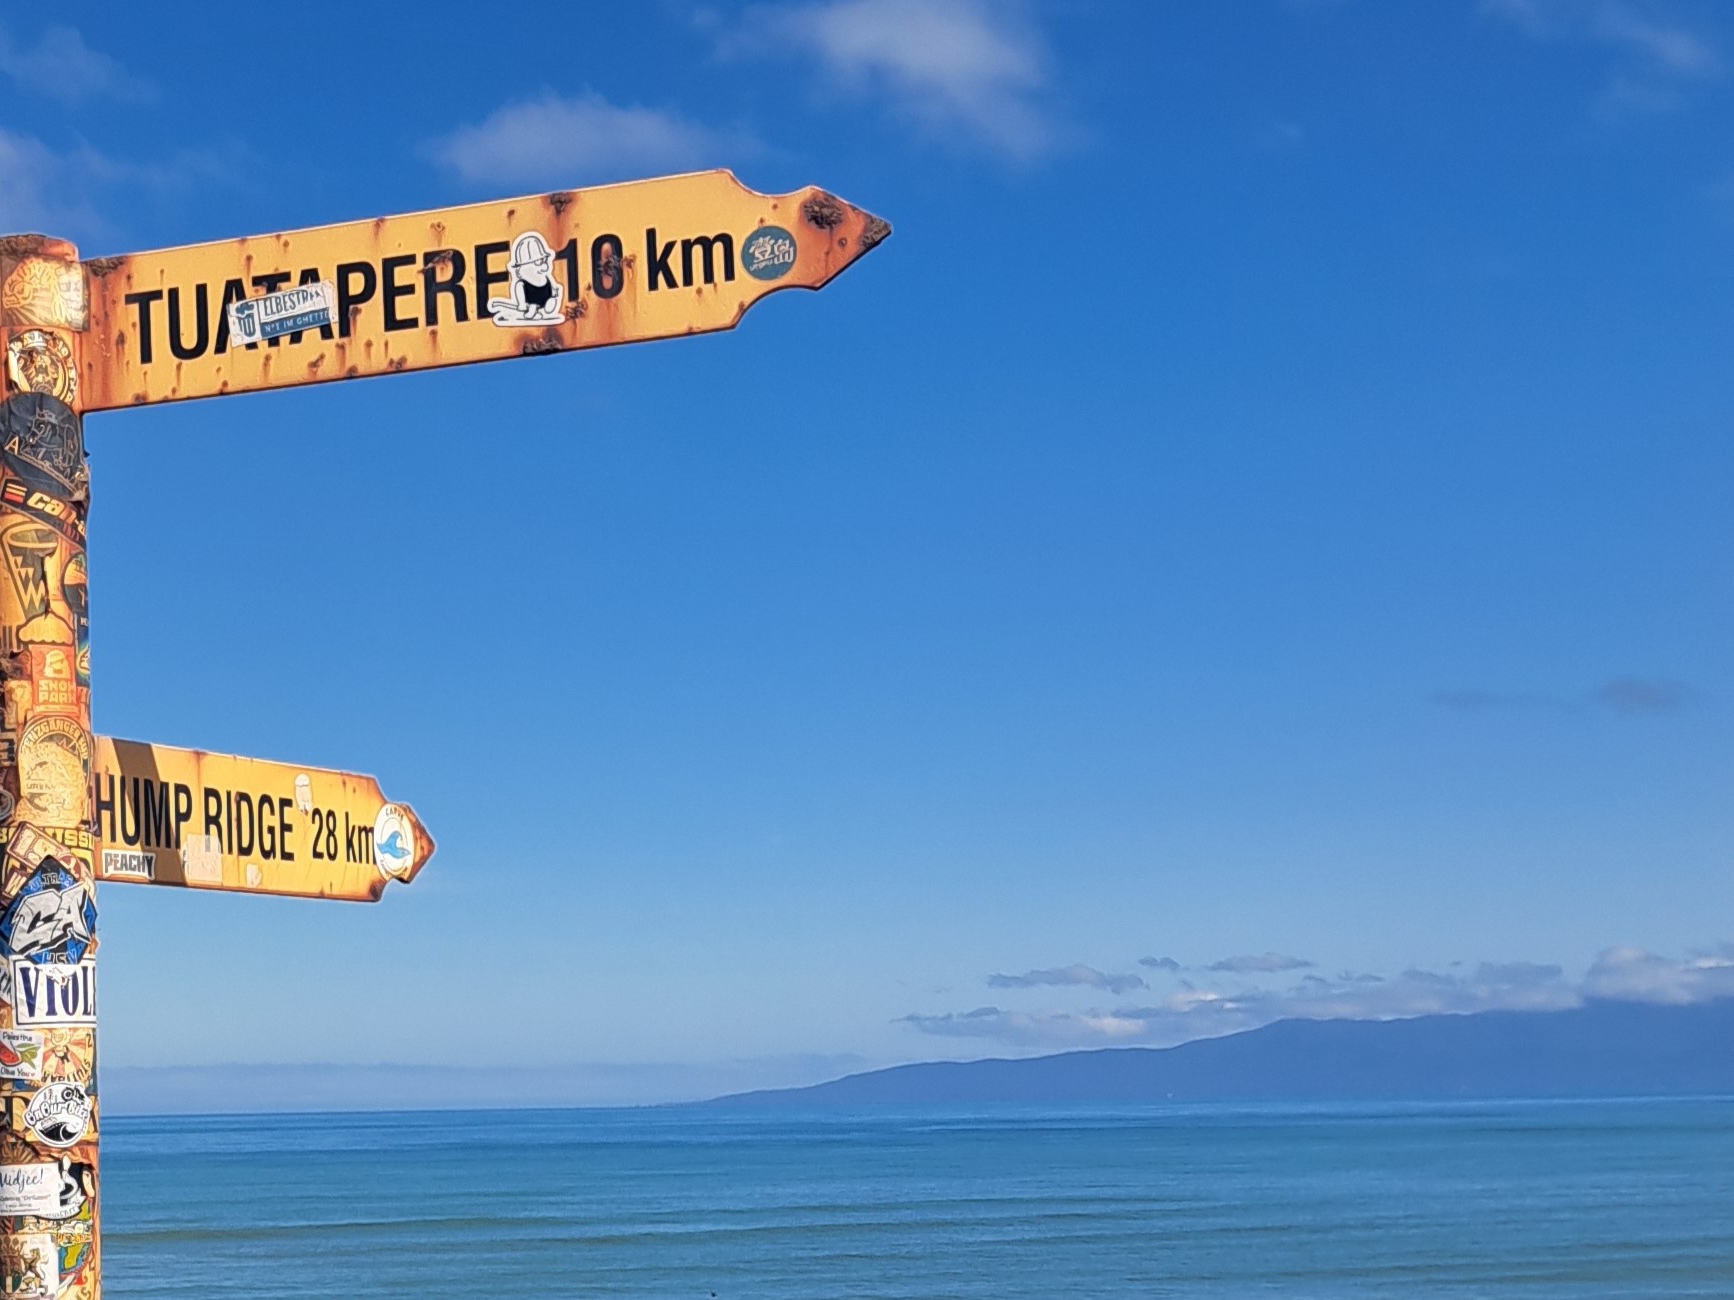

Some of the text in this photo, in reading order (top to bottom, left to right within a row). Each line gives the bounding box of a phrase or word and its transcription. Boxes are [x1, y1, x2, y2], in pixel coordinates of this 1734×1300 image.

[555, 233, 624, 303] 10
[646, 227, 735, 292] km
[95, 773, 377, 866] HUMP RIDGE 28 km
[19, 966, 96, 1017] VIOL
